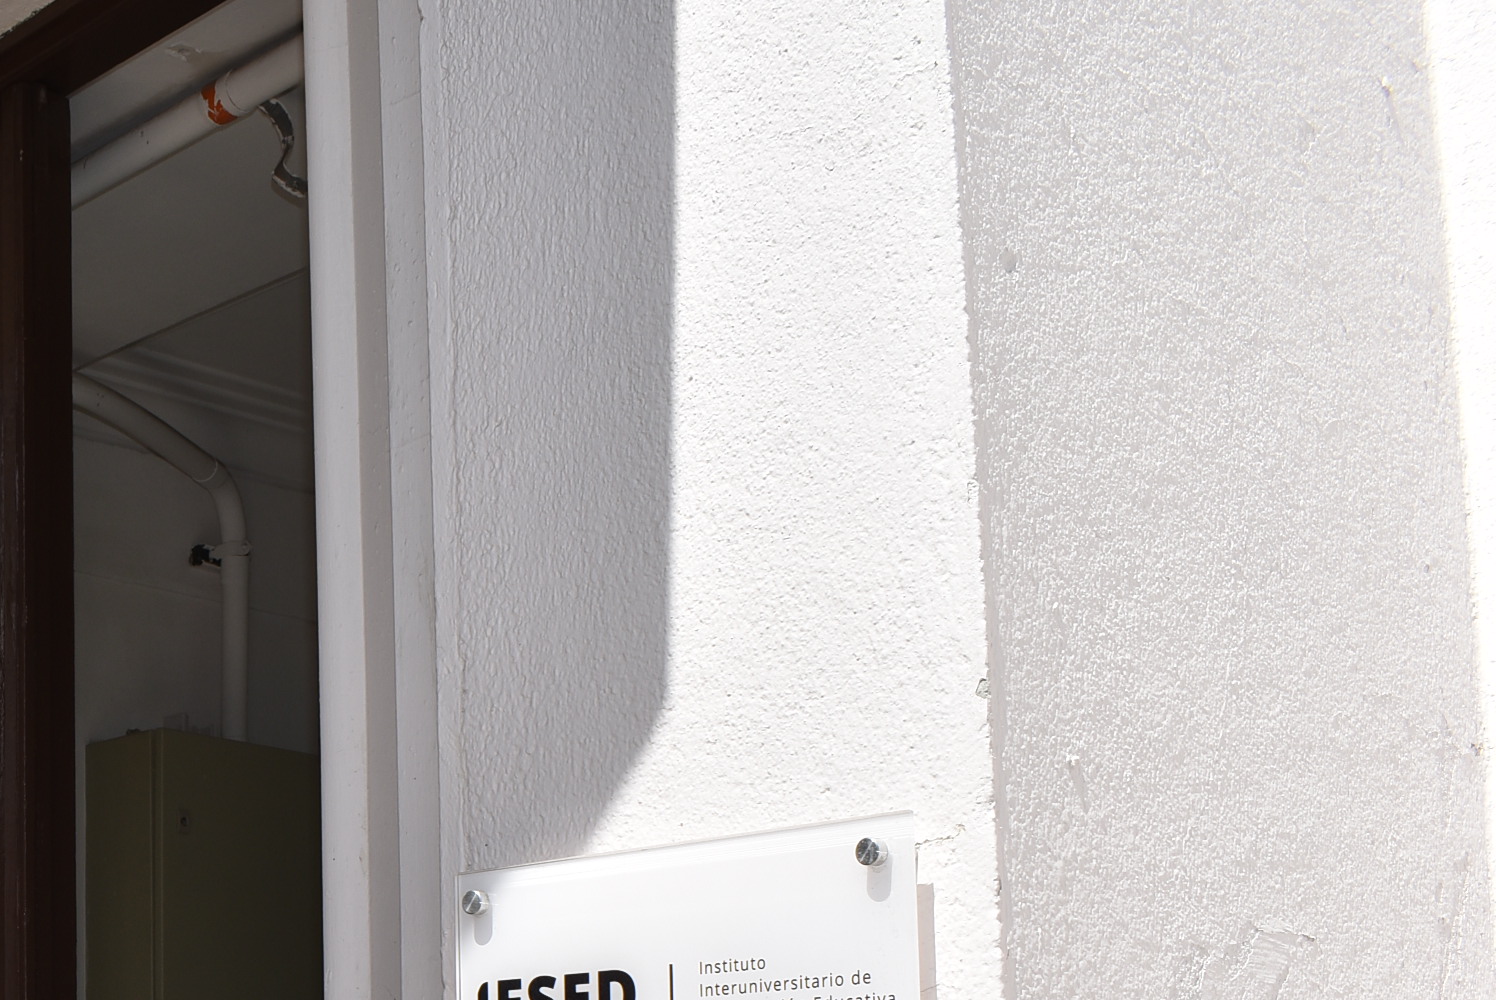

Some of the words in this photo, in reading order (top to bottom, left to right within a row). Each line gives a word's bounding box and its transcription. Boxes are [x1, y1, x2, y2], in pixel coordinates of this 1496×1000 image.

[699, 957, 766, 975] Instituto
[700, 972, 844, 998] Interuniversitario
[850, 969, 872, 986] de
